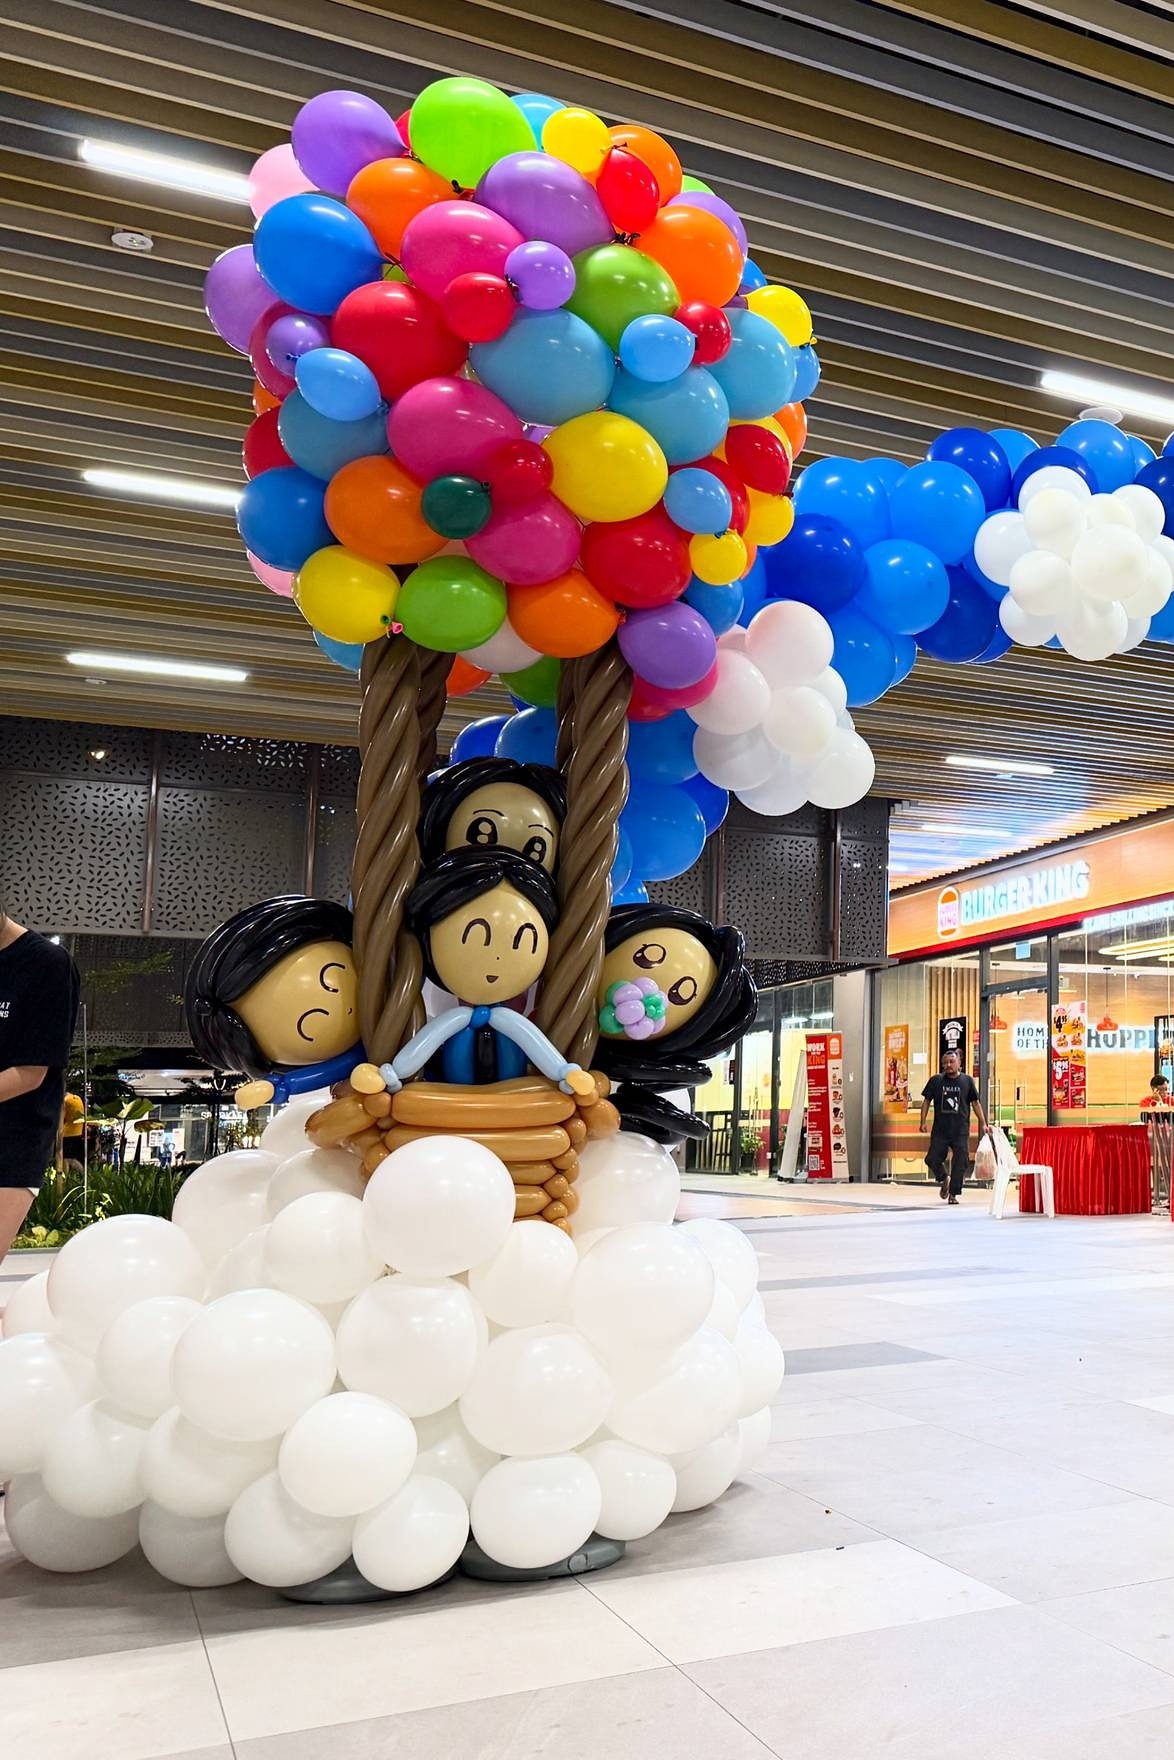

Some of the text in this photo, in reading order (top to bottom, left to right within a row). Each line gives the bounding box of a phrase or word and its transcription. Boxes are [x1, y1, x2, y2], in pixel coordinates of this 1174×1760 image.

[962, 860, 1089, 925] BURGER KING
[1017, 1027, 1048, 1037] HOM
[807, 1042, 826, 1052] WORK
[1017, 1039, 1048, 1049] OF TH
[807, 1054, 826, 1066] KING
